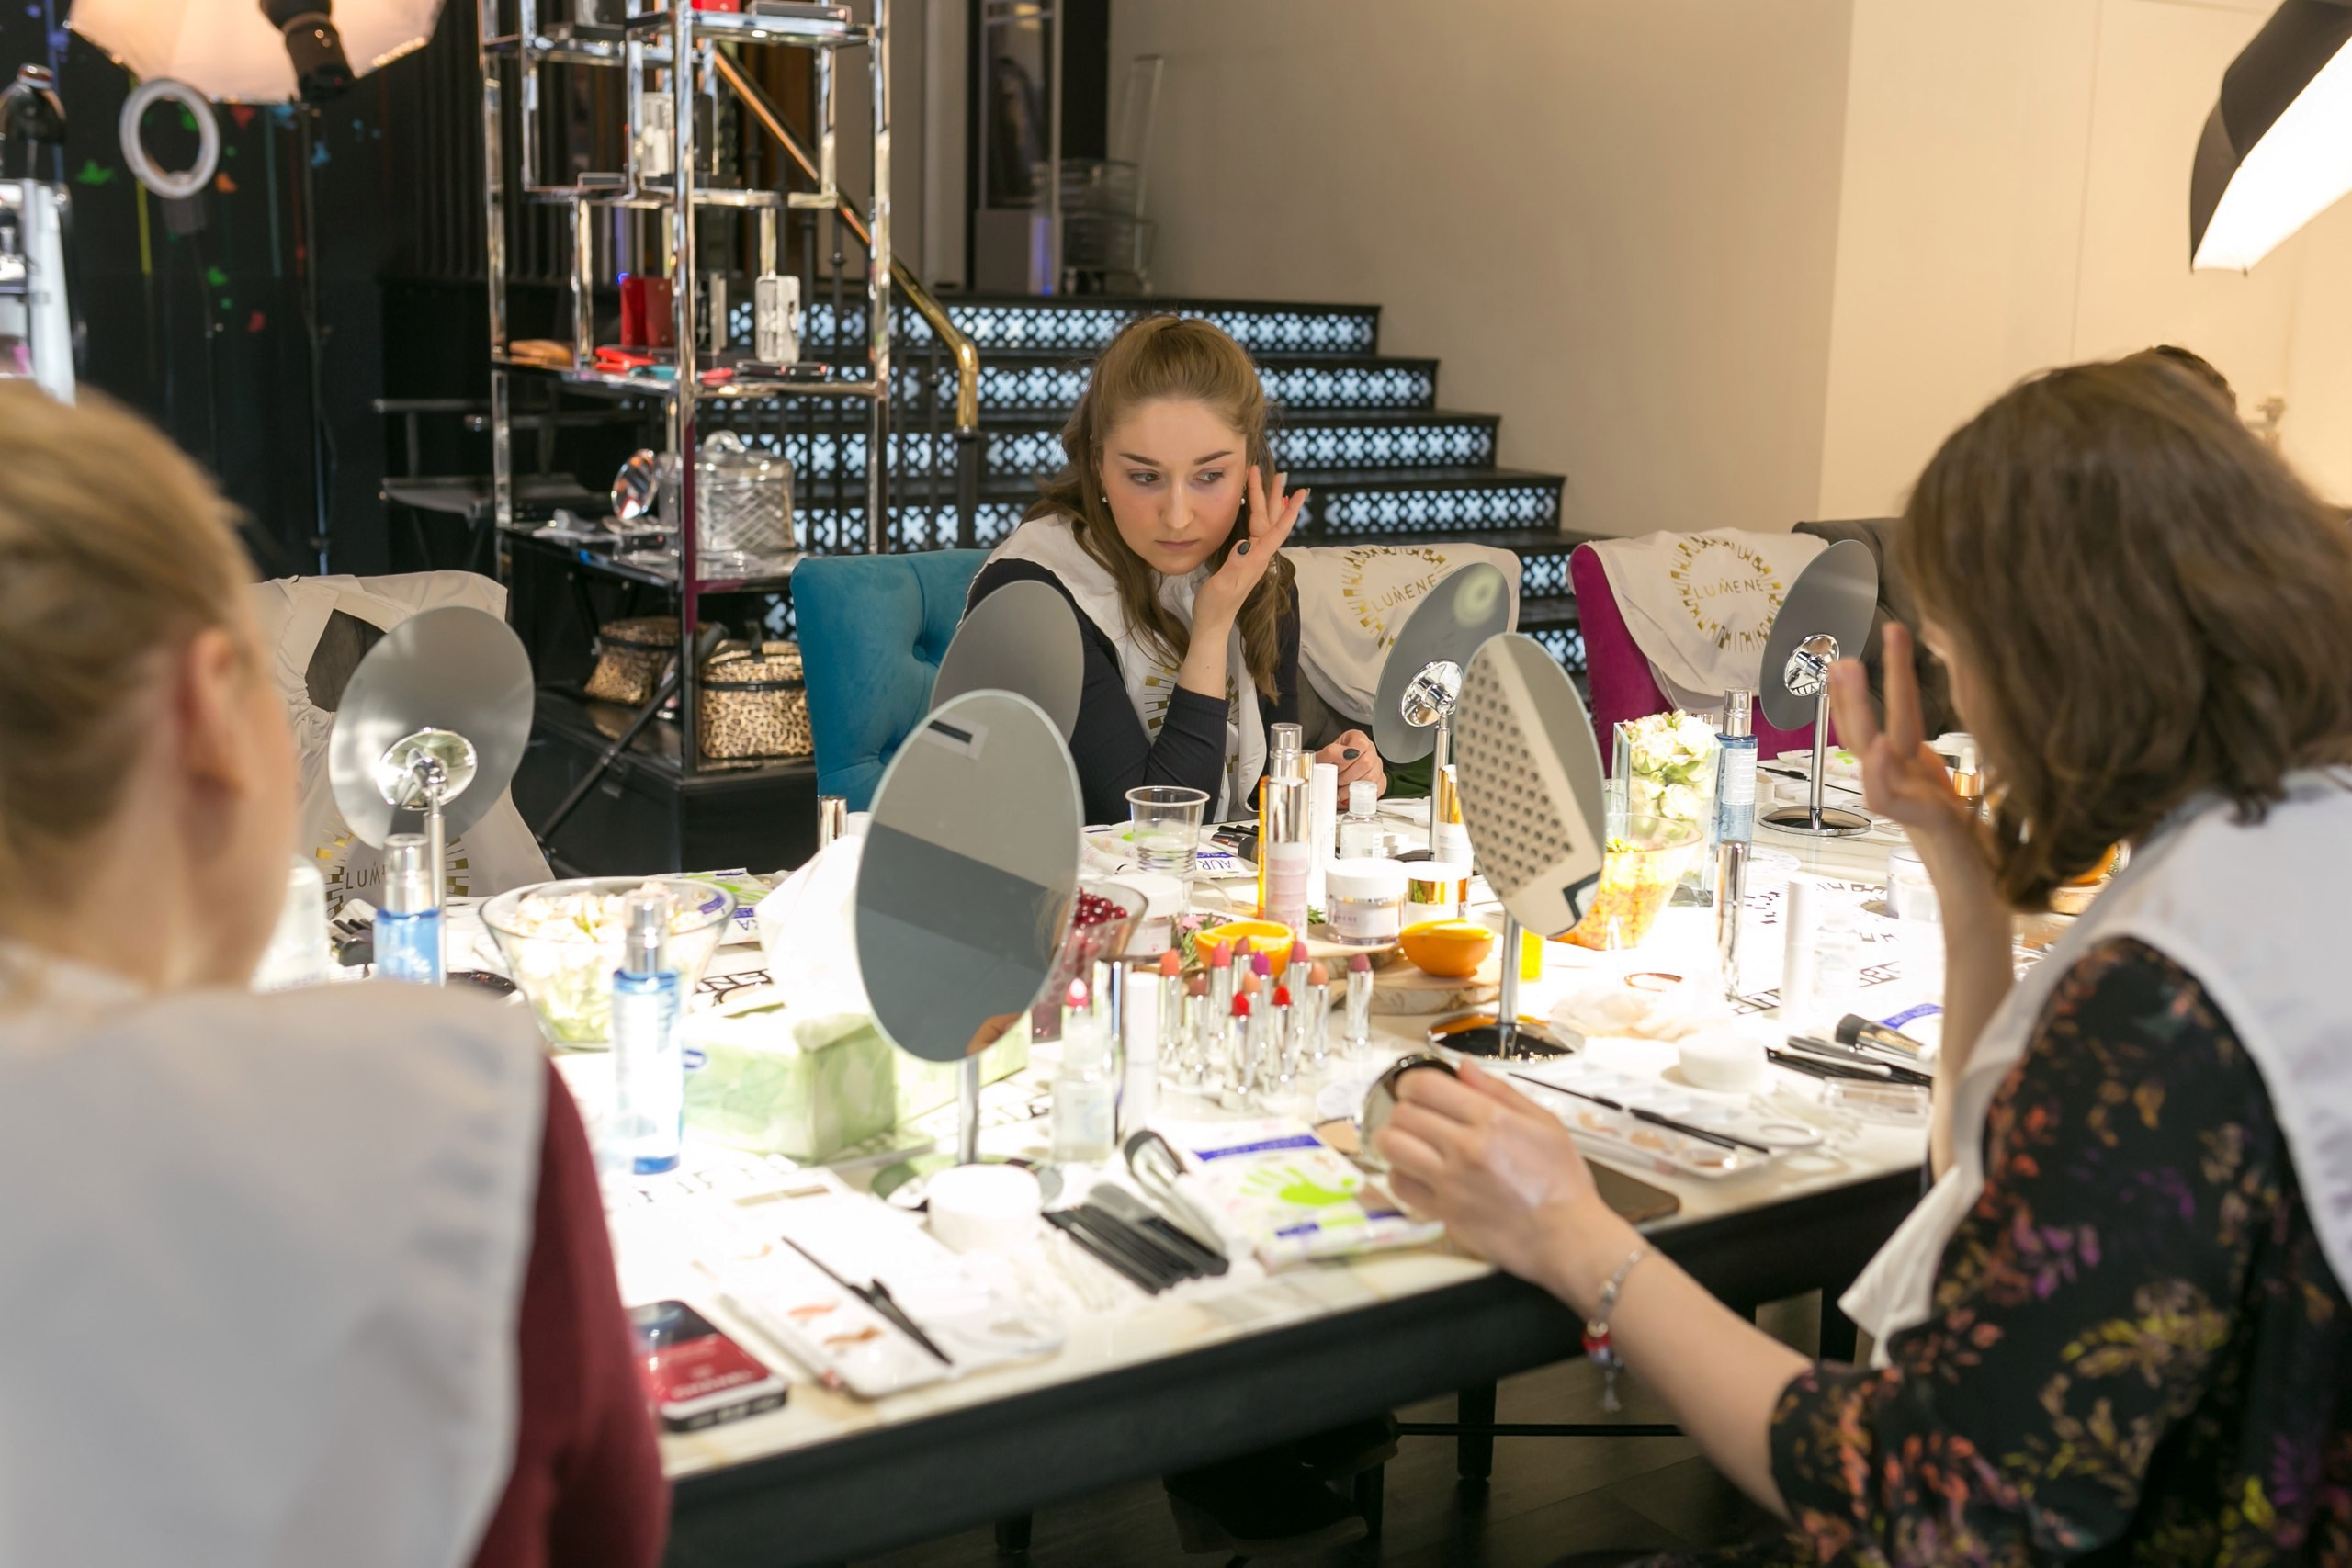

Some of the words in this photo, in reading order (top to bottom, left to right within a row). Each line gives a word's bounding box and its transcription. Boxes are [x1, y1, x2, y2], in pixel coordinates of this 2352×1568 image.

[1370, 573, 1436, 612] LUMENE
[1692, 577, 1764, 600] LUMENE
[345, 862, 386, 890] LUM
[1195, 859, 1232, 871] AUR
